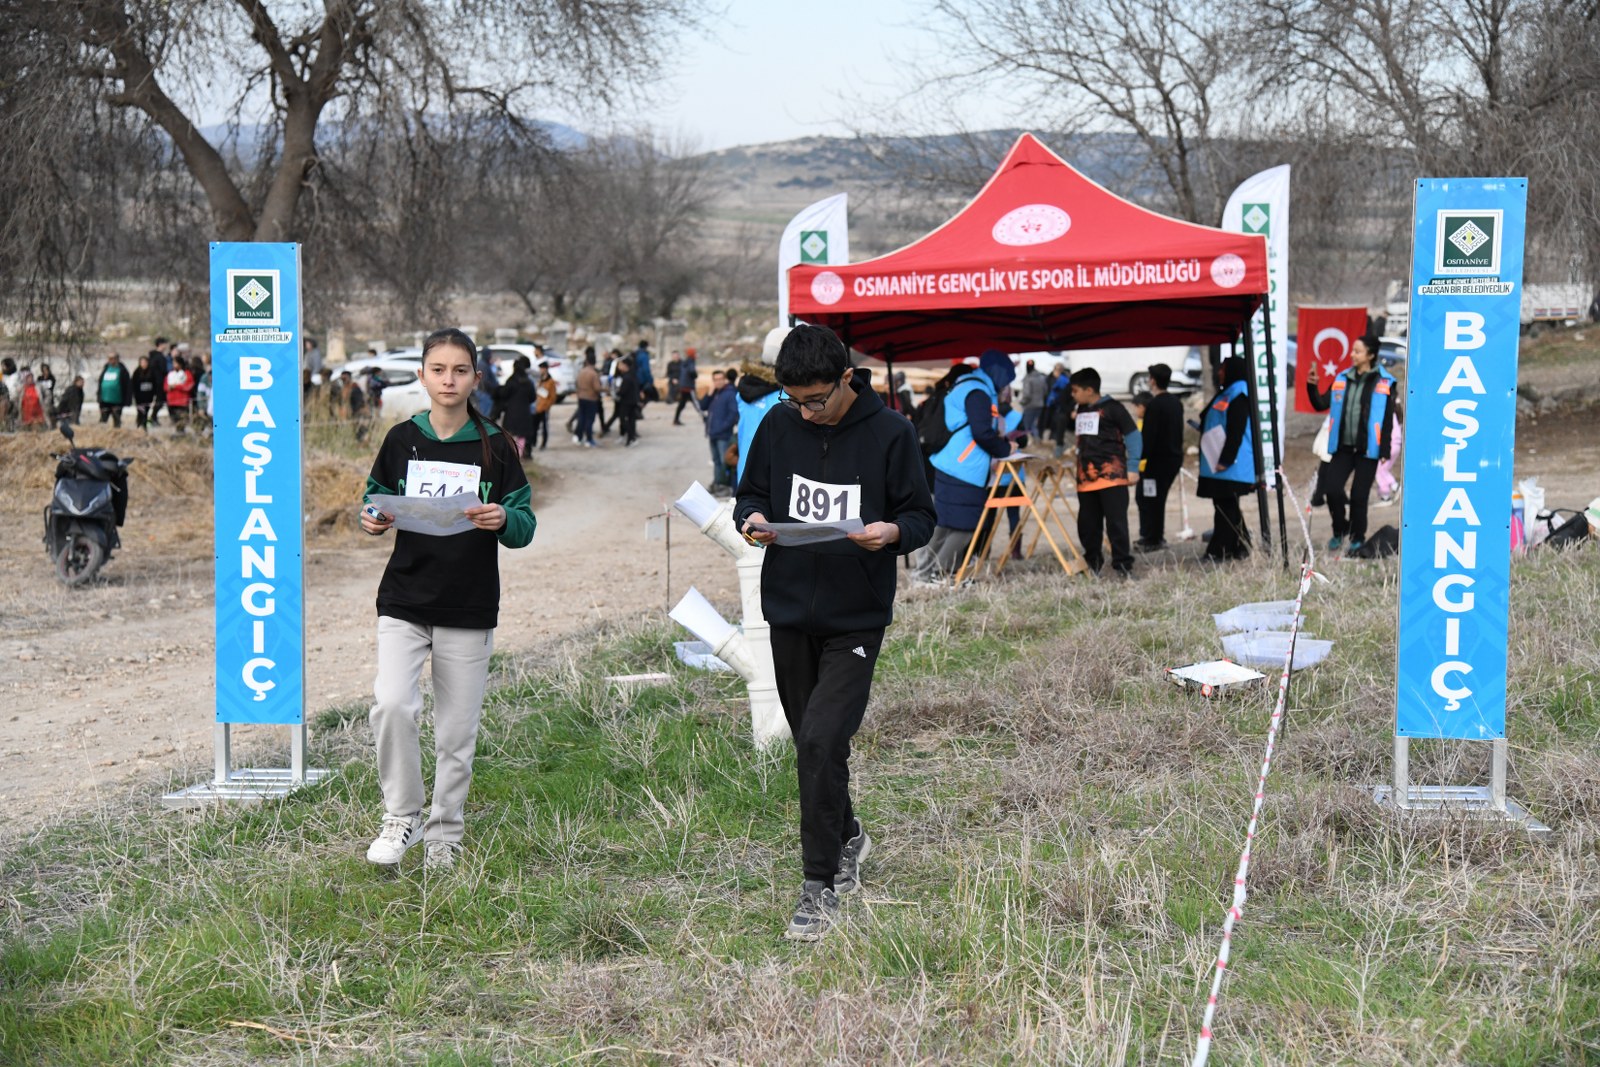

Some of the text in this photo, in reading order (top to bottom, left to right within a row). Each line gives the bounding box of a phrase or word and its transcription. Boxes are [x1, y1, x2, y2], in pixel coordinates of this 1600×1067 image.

[854, 259, 1201, 298] OSMANİYE GENÇLİK VE SPOR İL MÜDÜRLÜĞÜ
[1446, 257, 1489, 265] OSMANİYE
[796, 483, 848, 521] 891
[1430, 311, 1487, 712] BAŞLANGIÇ
[236, 356, 278, 702] BAŞLANGIÇ
